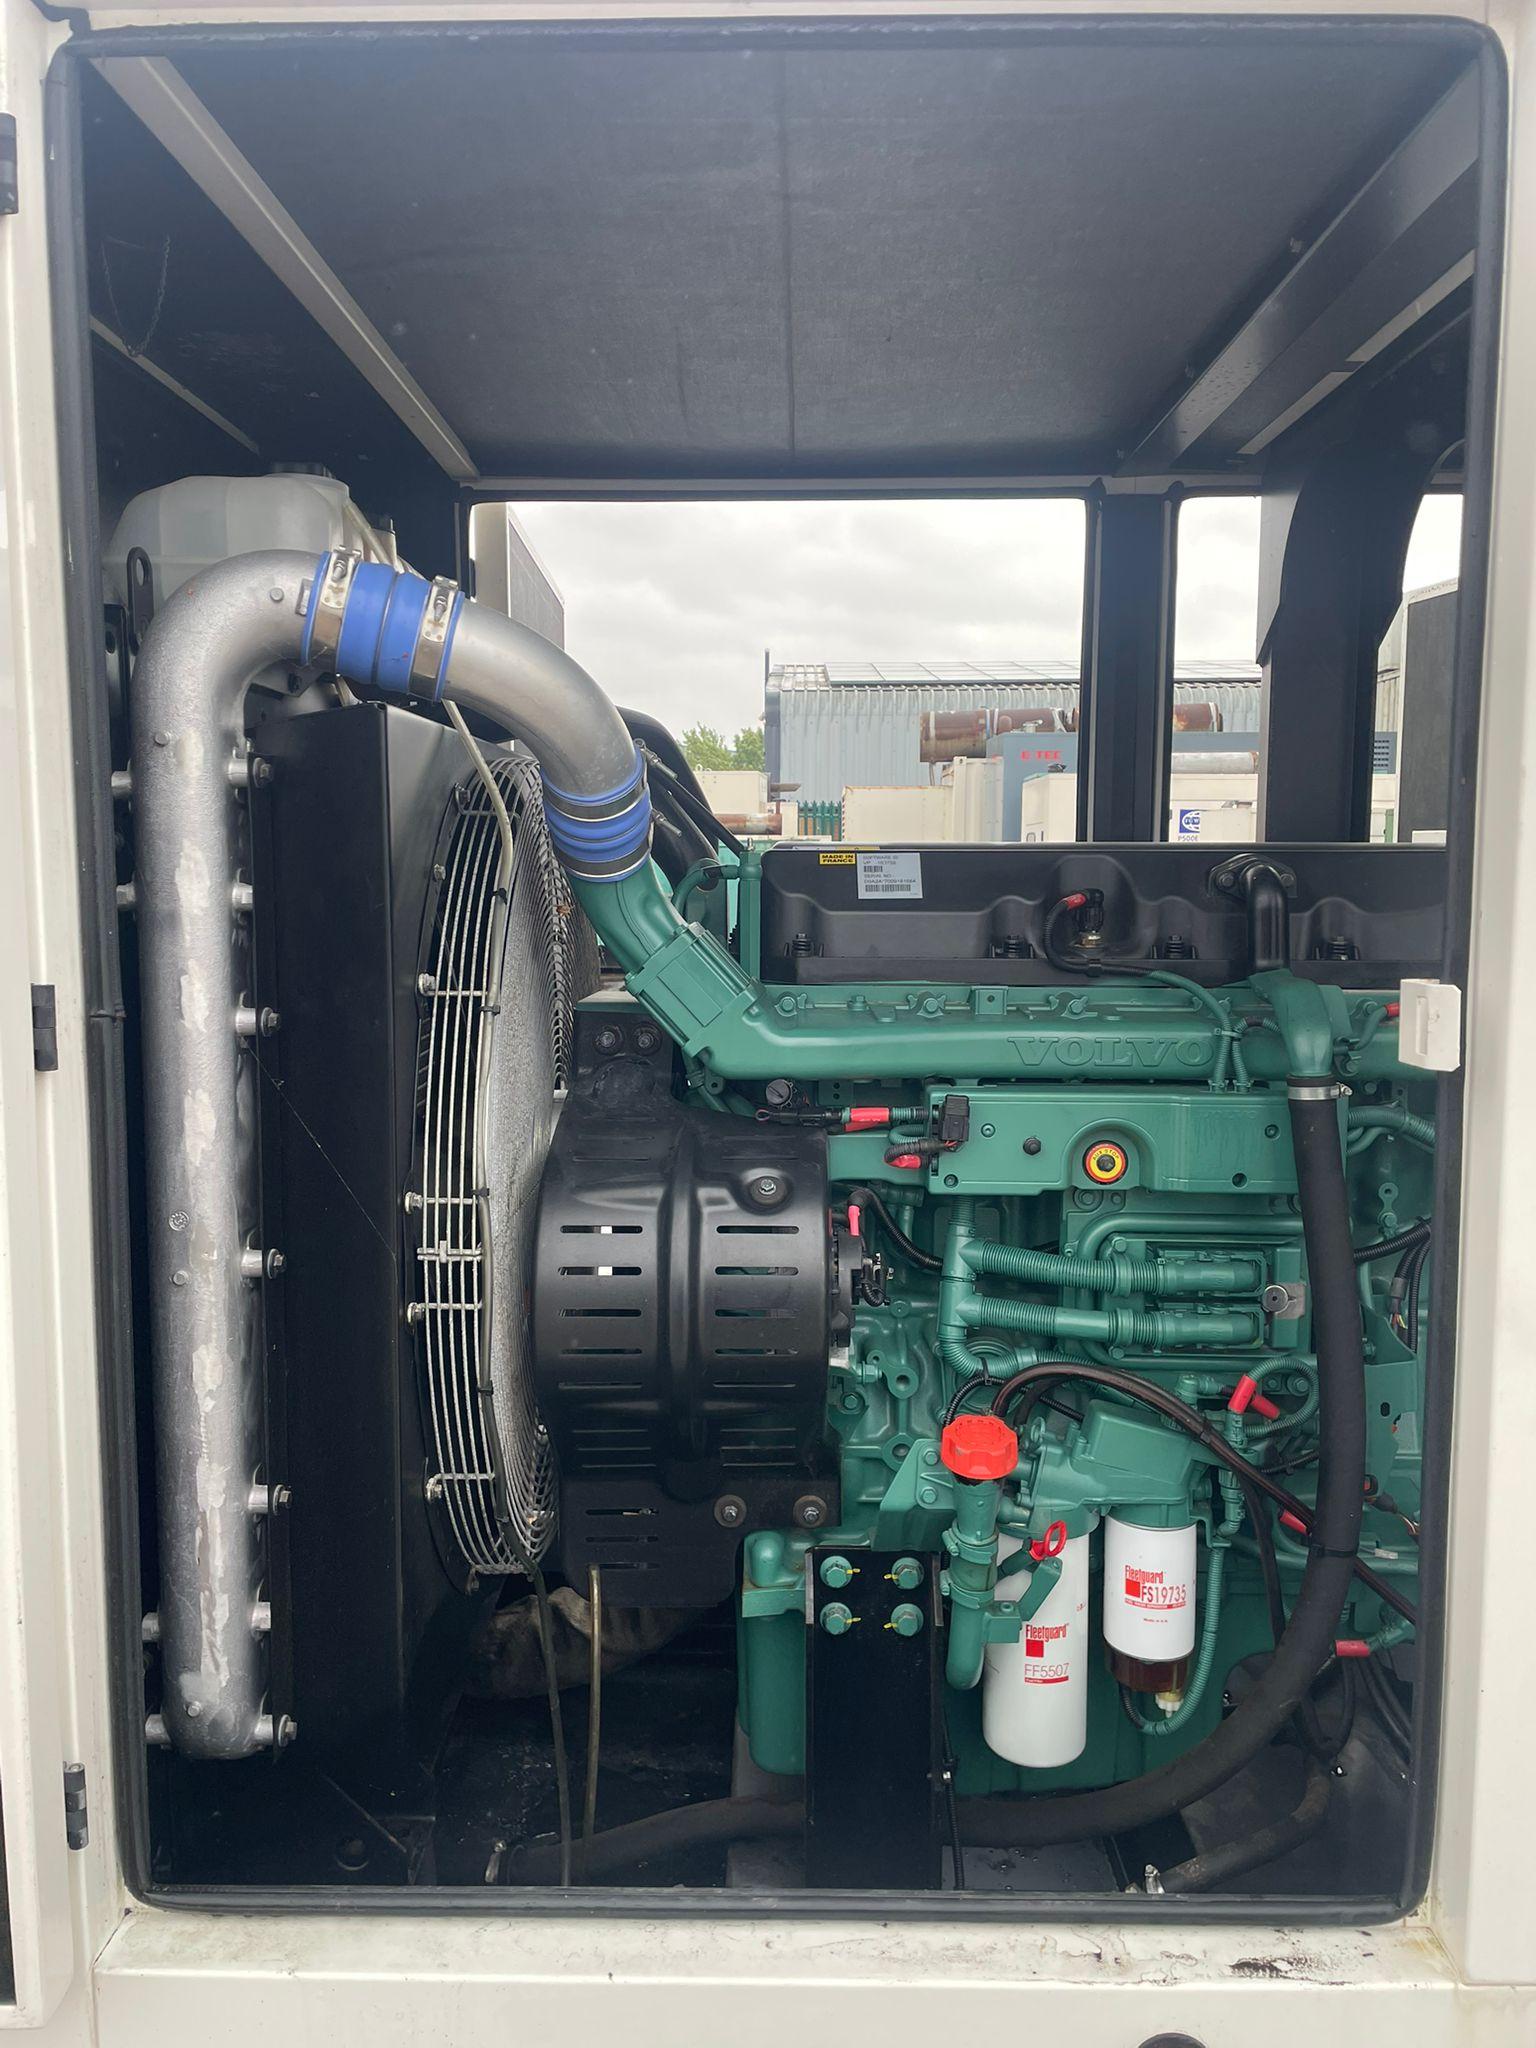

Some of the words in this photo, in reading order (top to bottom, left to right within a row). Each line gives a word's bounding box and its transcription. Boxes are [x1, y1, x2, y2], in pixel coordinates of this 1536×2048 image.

[1007, 1036, 1214, 1067] VOLVO
[1092, 1150, 1103, 1161] AUX
[1104, 1149, 1120, 1160] STOP
[1124, 1564, 1164, 1585] Fleetguard
[1141, 1584, 1187, 1604] FS19735
[1025, 1623, 1067, 1643] Fleetguard
[1024, 1662, 1070, 1678] FF5507
